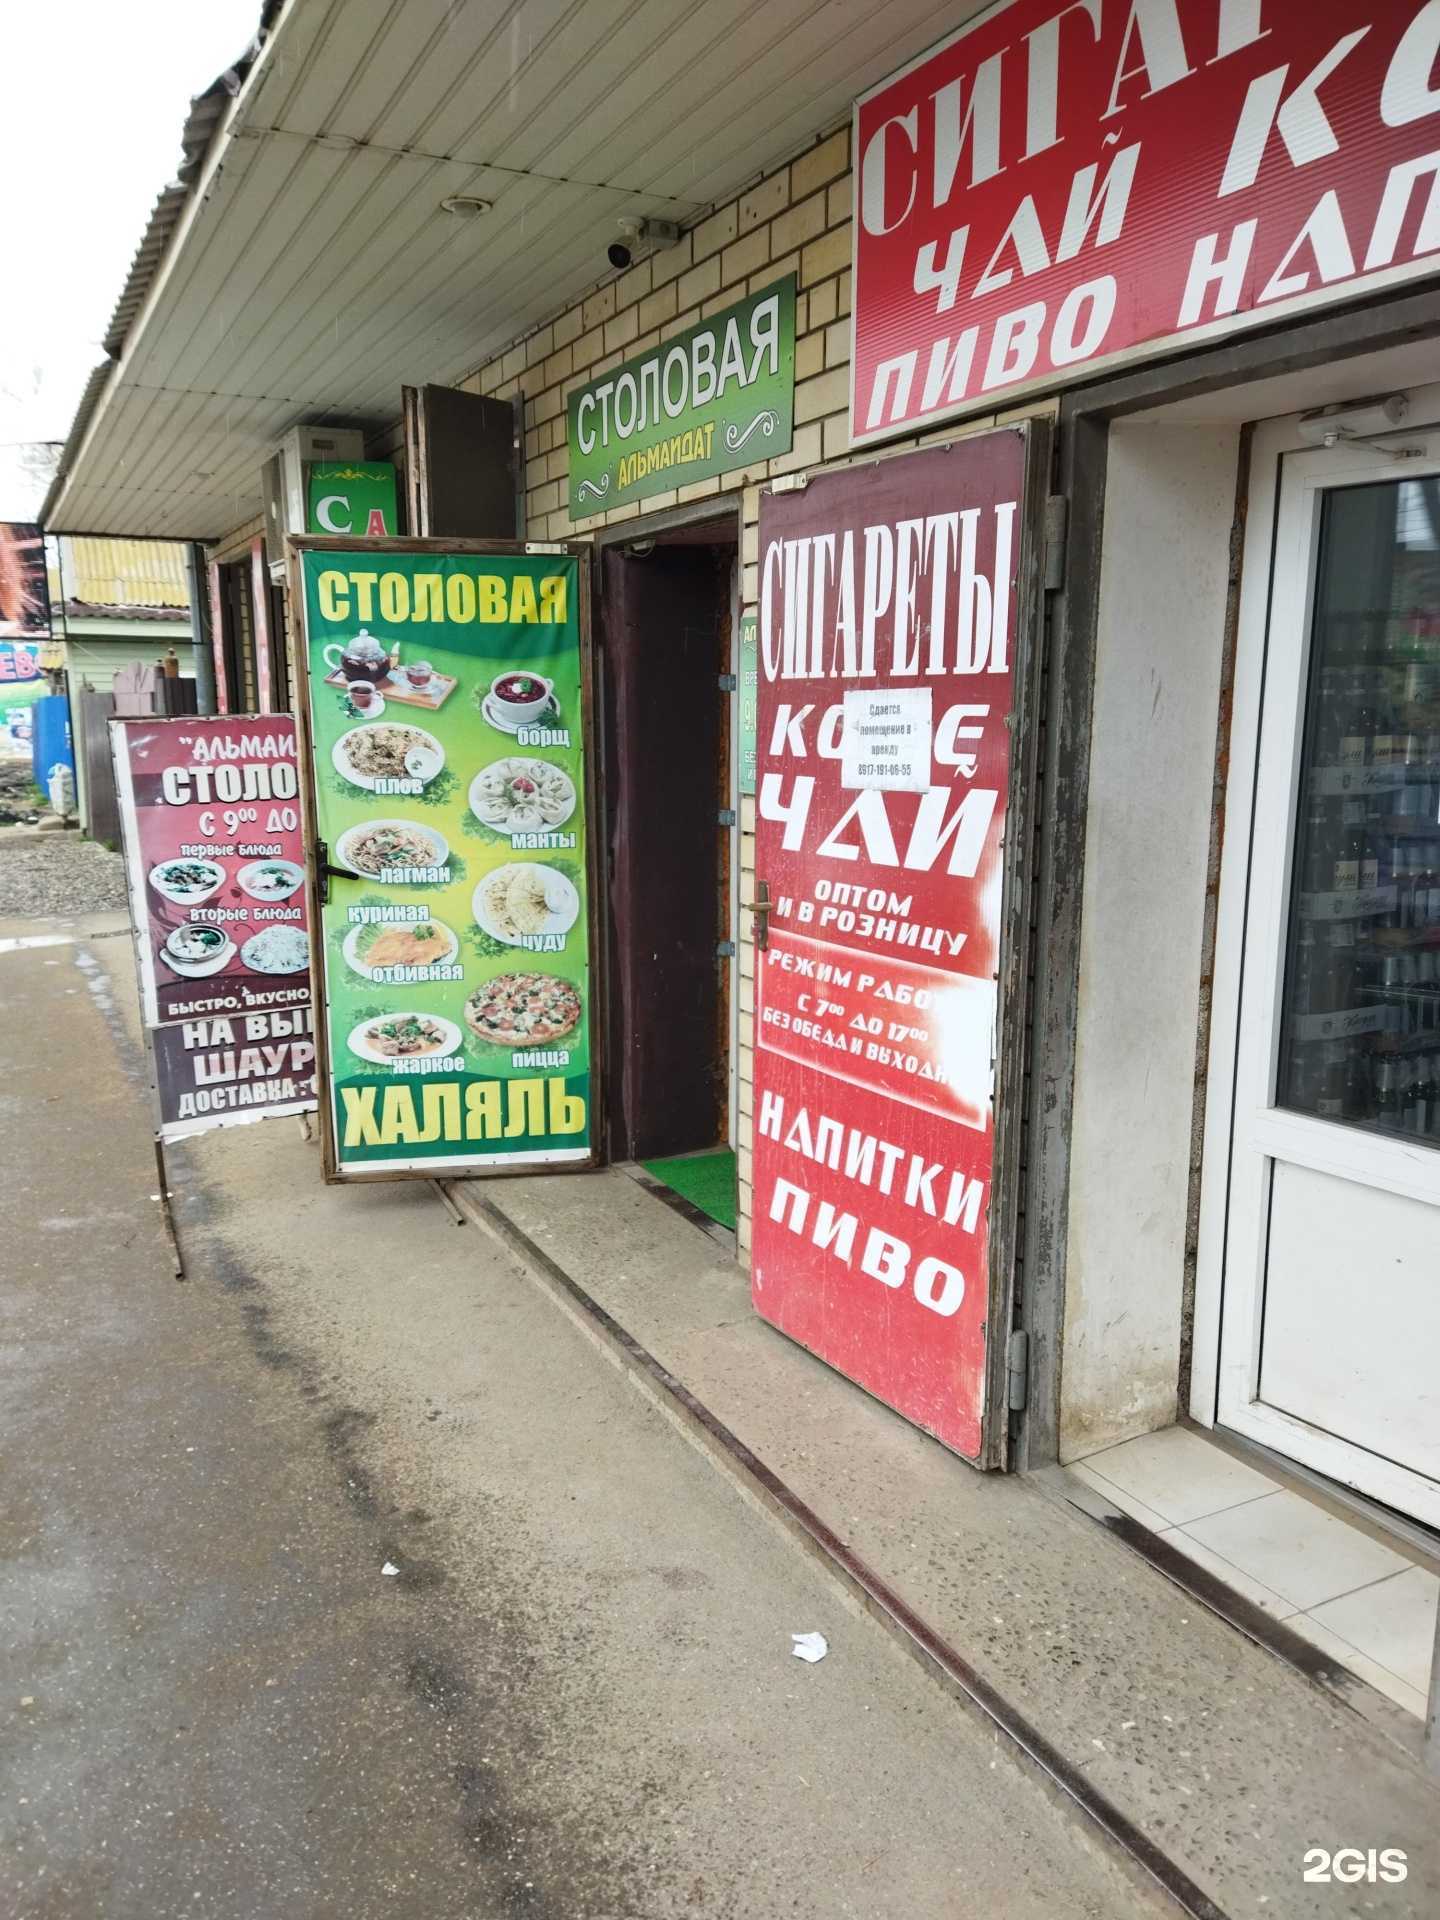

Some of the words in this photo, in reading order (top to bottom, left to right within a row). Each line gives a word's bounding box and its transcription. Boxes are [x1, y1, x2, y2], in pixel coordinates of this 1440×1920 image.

[913, 126, 1142, 315] ЧАЙ
[865, 274, 1118, 430] ПИВО
[577, 294, 779, 456] СТОЛОВАЯ
[318, 570, 568, 624] СТОЛОВАЯ
[760, 501, 1017, 682] СИГАРЕТЫ
[517, 726, 571, 748] борщ
[769, 704, 990, 766] КОЕ
[162, 762, 298, 806] СТОЛО
[374, 777, 425, 796] плов
[265, 807, 297, 833] ДО
[511, 831, 577, 850] манты
[759, 764, 999, 878] ЧАЙ
[180, 843, 235, 860] первые
[238, 842, 283, 857] блюда
[379, 866, 451, 885] лагман
[190, 907, 249, 925] вторые
[253, 907, 302, 921] блюда
[348, 904, 430, 924] куриная
[814, 879, 913, 918] ОПТОМ
[521, 933, 568, 953] чуду
[776, 896, 794, 919] И
[797, 902, 816, 923] В
[819, 906, 969, 957] РОЗНИЦУ
[371, 963, 465, 984] отбивная
[767, 948, 853, 989] РЕЖИМ
[168, 996, 242, 1016] БЫСТРО,
[797, 993, 812, 1013] С
[850, 1013, 884, 1036] ДО
[182, 1018, 236, 1051] НА
[763, 1006, 790, 1030] БЕЗ
[792, 1017, 848, 1051] ОБЕДА
[850, 1036, 863, 1056] И
[193, 1041, 315, 1087] ШАУР
[392, 1055, 465, 1074] жаркое
[512, 1049, 570, 1069] пицца
[341, 1077, 586, 1148] ХАЛЯЛЬ
[759, 1089, 985, 1235] НАПИТКИ
[769, 1176, 966, 1317] ПИВО
